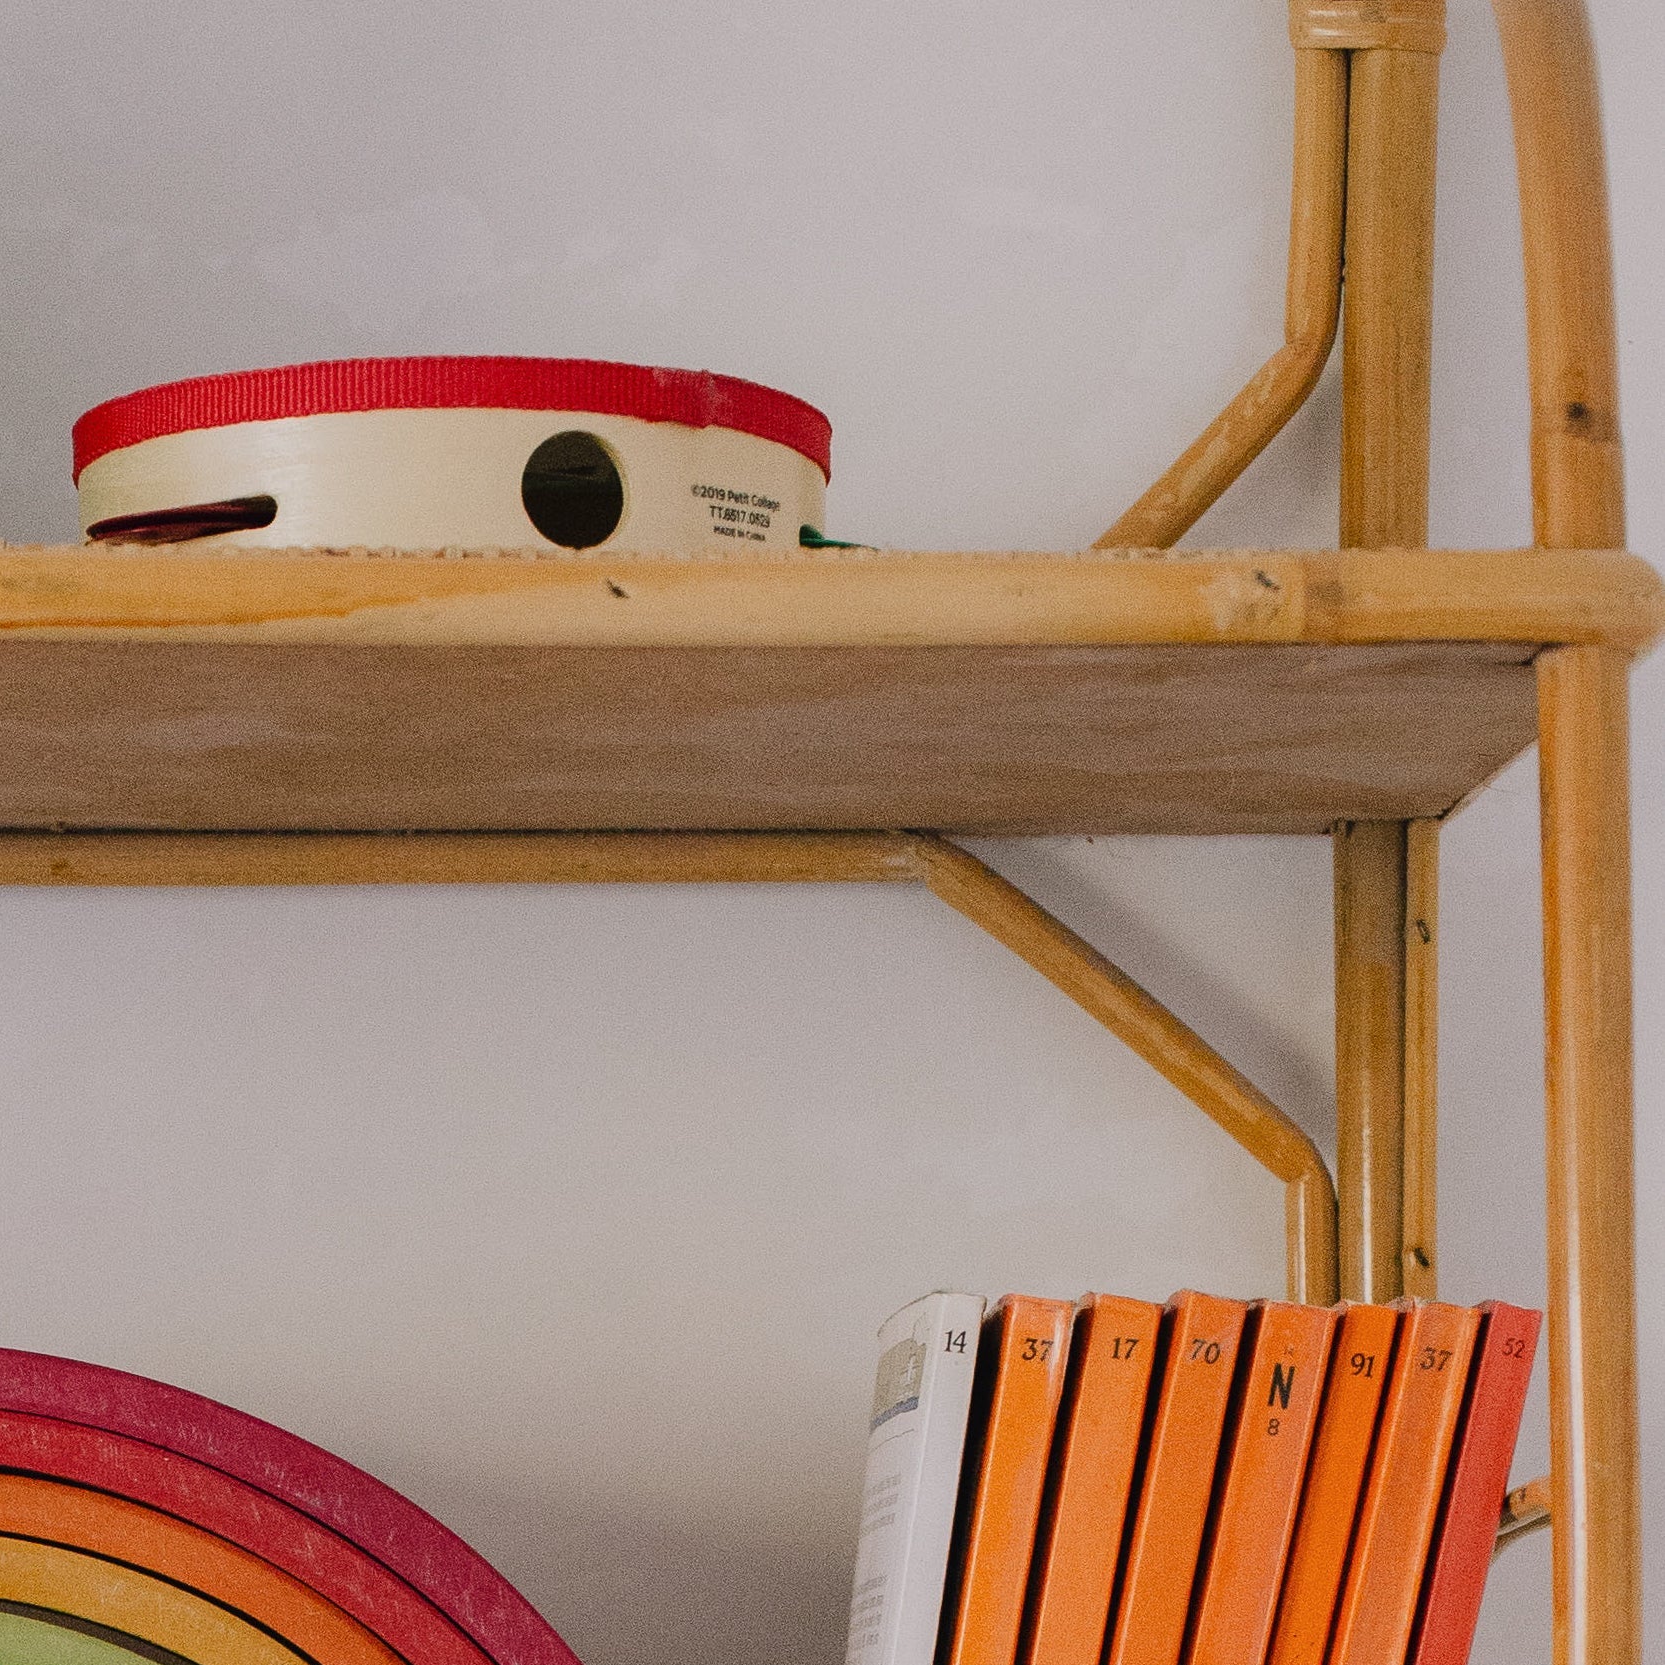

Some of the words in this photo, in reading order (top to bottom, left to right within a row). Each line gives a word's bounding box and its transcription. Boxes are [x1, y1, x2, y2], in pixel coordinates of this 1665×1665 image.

[727, 489, 749, 504] Petit
[944, 1330, 967, 1354] 14
[1021, 1337, 1055, 1362] 37
[1111, 1337, 1139, 1360] 17
[1190, 1338, 1221, 1365] 70
[1502, 1338, 1526, 1359] 52
[1350, 1352, 1375, 1378] 91
[1419, 1347, 1453, 1372] 37
[1267, 1362, 1295, 1409] N
[1267, 1418, 1280, 1436] 8
